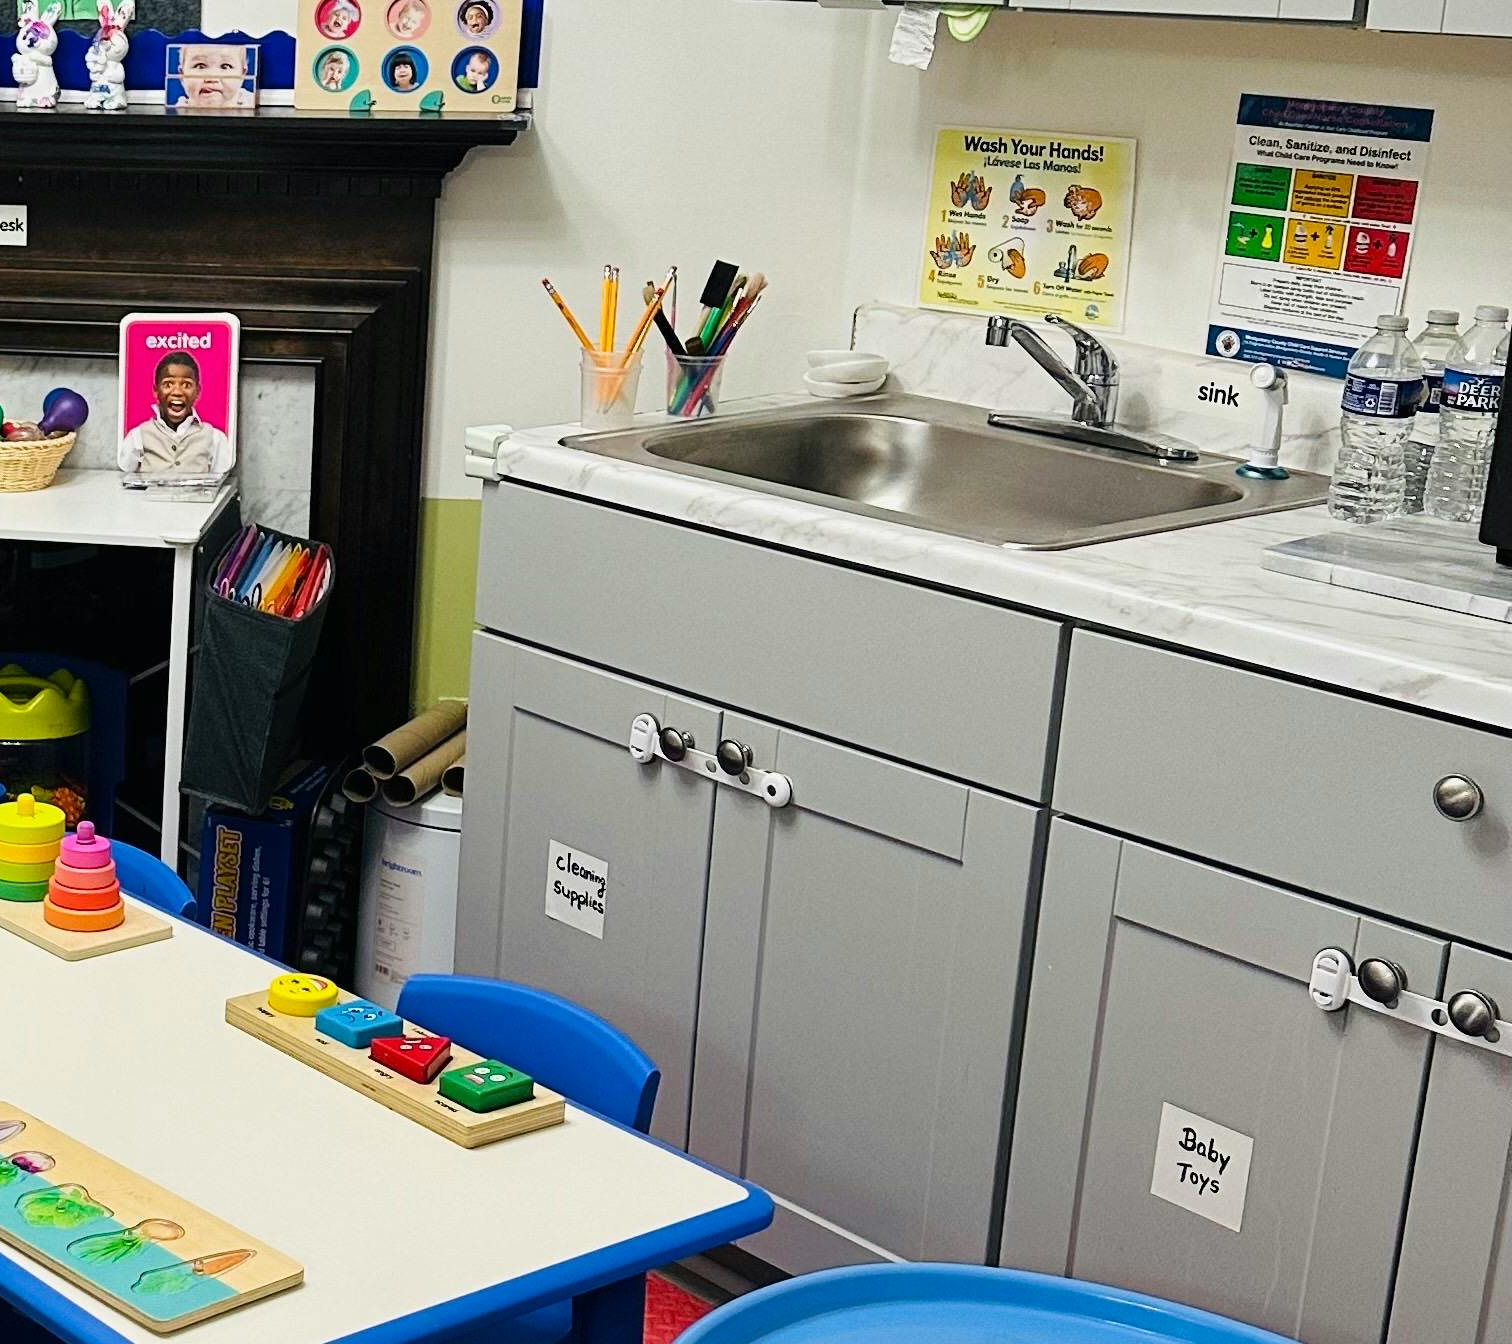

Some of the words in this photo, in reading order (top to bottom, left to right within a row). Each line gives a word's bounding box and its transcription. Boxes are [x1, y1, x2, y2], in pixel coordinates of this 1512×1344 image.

[964, 136, 1007, 154] Wash
[1011, 139, 1046, 157] Your
[1049, 142, 1104, 162] Hands!
[1249, 135, 1283, 150] Clean,
[1285, 138, 1333, 154] Sanitize,
[1335, 145, 1357, 156] and
[1359, 146, 1412, 161] Disinfect
[1023, 159, 1041, 170] Las
[1043, 161, 1081, 174] Manos!
[1311, 155, 1345, 165] Programs
[1346, 158, 1366, 167] Need
[1002, 215, 1009, 228] 2
[1012, 216, 1029, 224] Soap
[1056, 220, 1074, 228] Wash
[987, 276, 999, 284] Dry
[145, 332, 212, 350] excited
[1198, 382, 1239, 407] sink
[1459, 381, 1501, 397] DEER
[1456, 394, 1500, 410] PARK
[213, 825, 242, 913] PLAYSET
[1179, 1127, 1230, 1175] Baby
[1177, 1162, 1220, 1195] Toys
